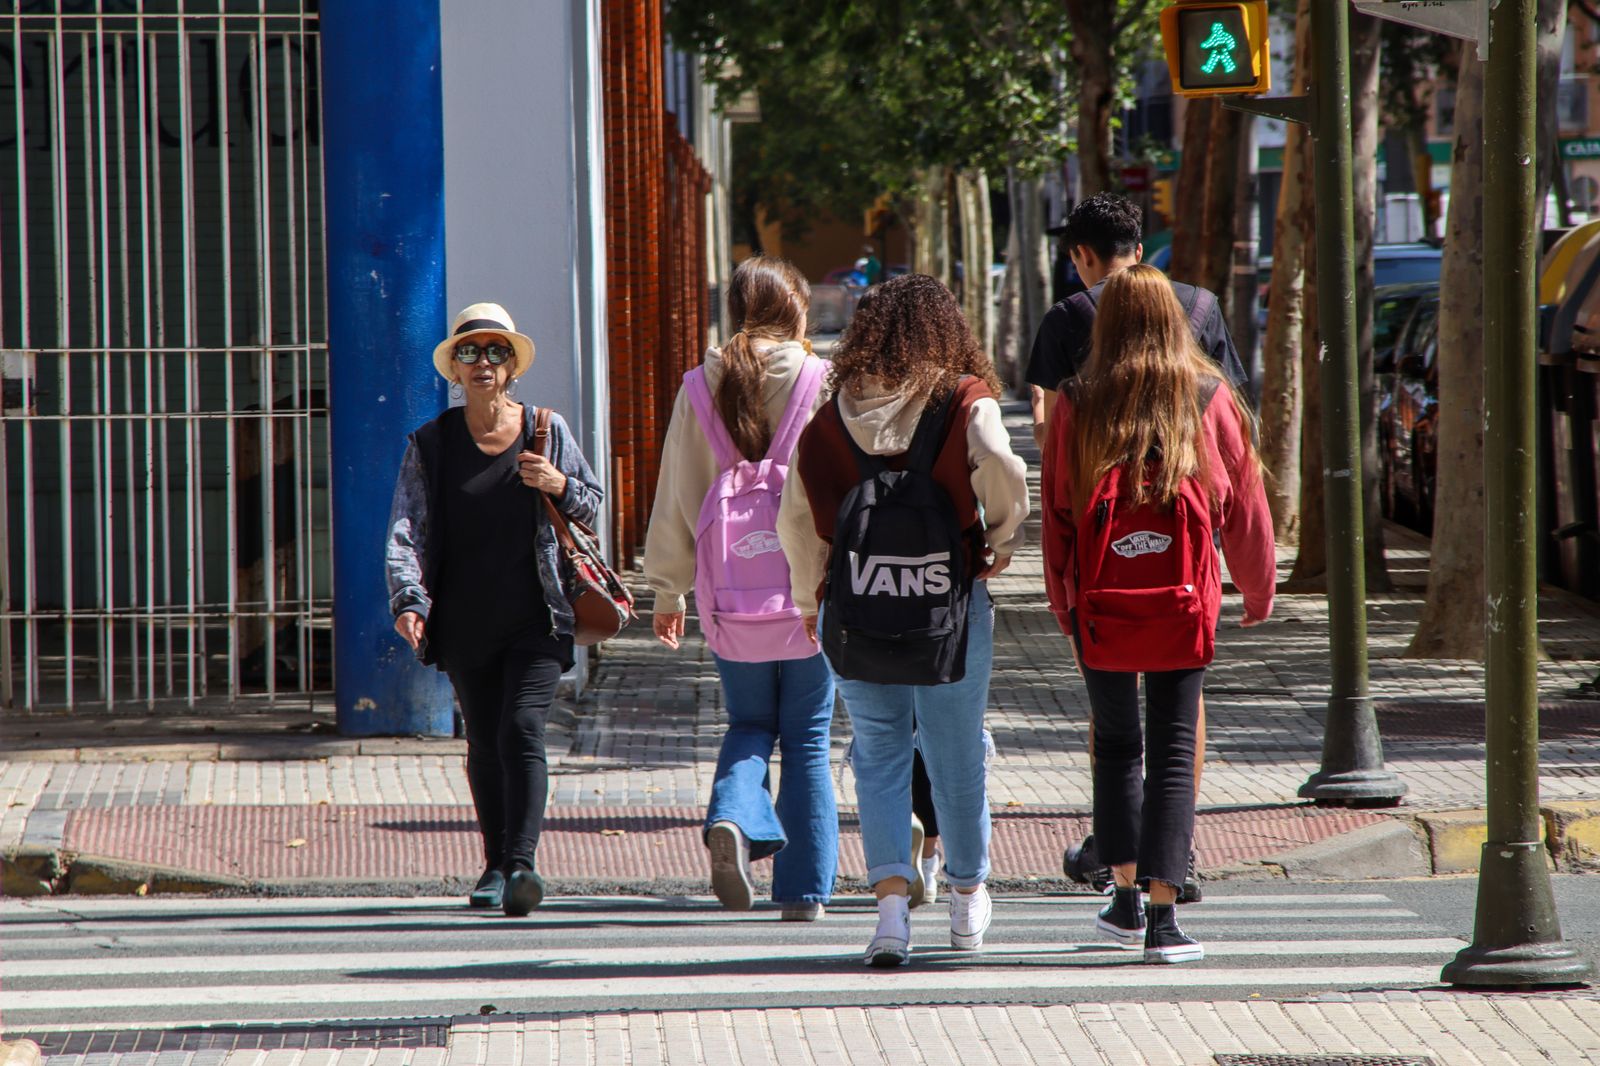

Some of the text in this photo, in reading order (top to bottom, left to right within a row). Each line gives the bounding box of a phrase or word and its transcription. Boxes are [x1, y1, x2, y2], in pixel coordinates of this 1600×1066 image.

[1128, 534, 1151, 543] VANS
[1134, 541, 1148, 550] THE
[848, 551, 951, 597] VANS
